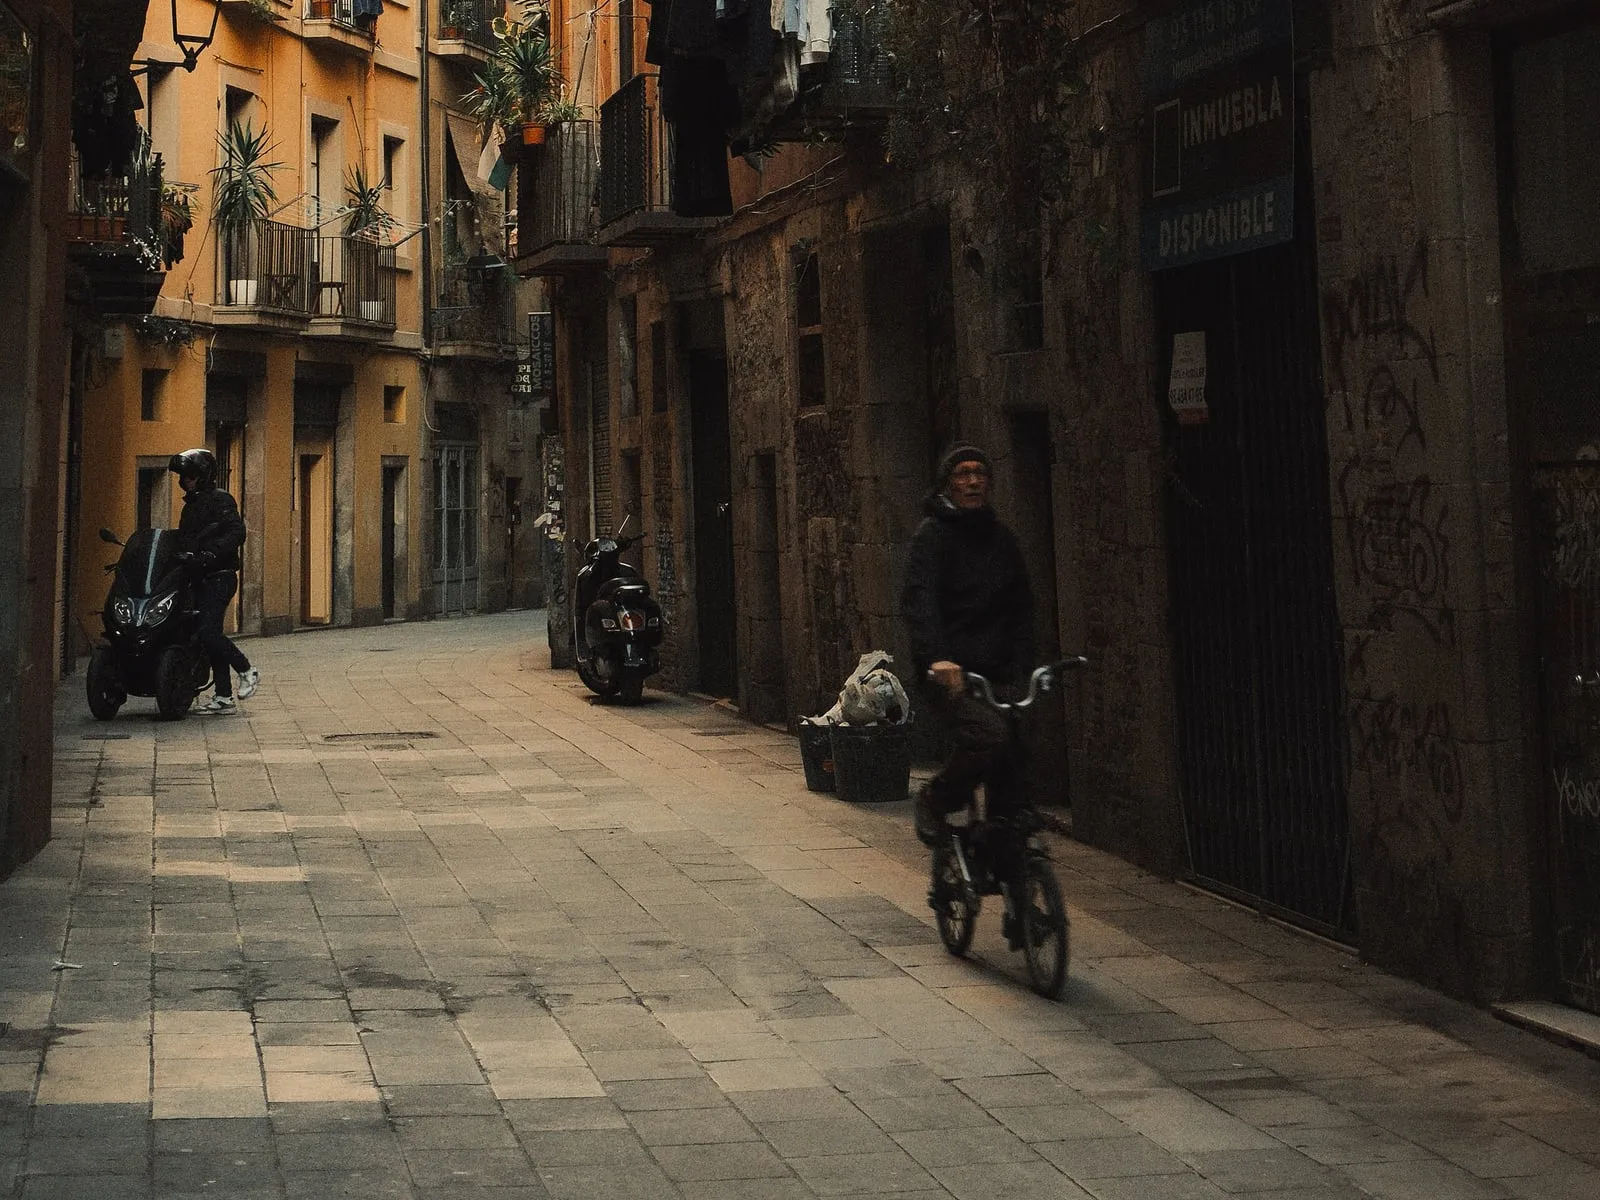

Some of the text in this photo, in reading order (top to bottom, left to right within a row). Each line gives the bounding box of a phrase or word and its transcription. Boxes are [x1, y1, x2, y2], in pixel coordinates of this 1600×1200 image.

[1183, 75, 1283, 149] INMUEBLA
[1159, 191, 1275, 258] DISPONIBLE
[530, 315, 543, 390] MOSAICCOS
